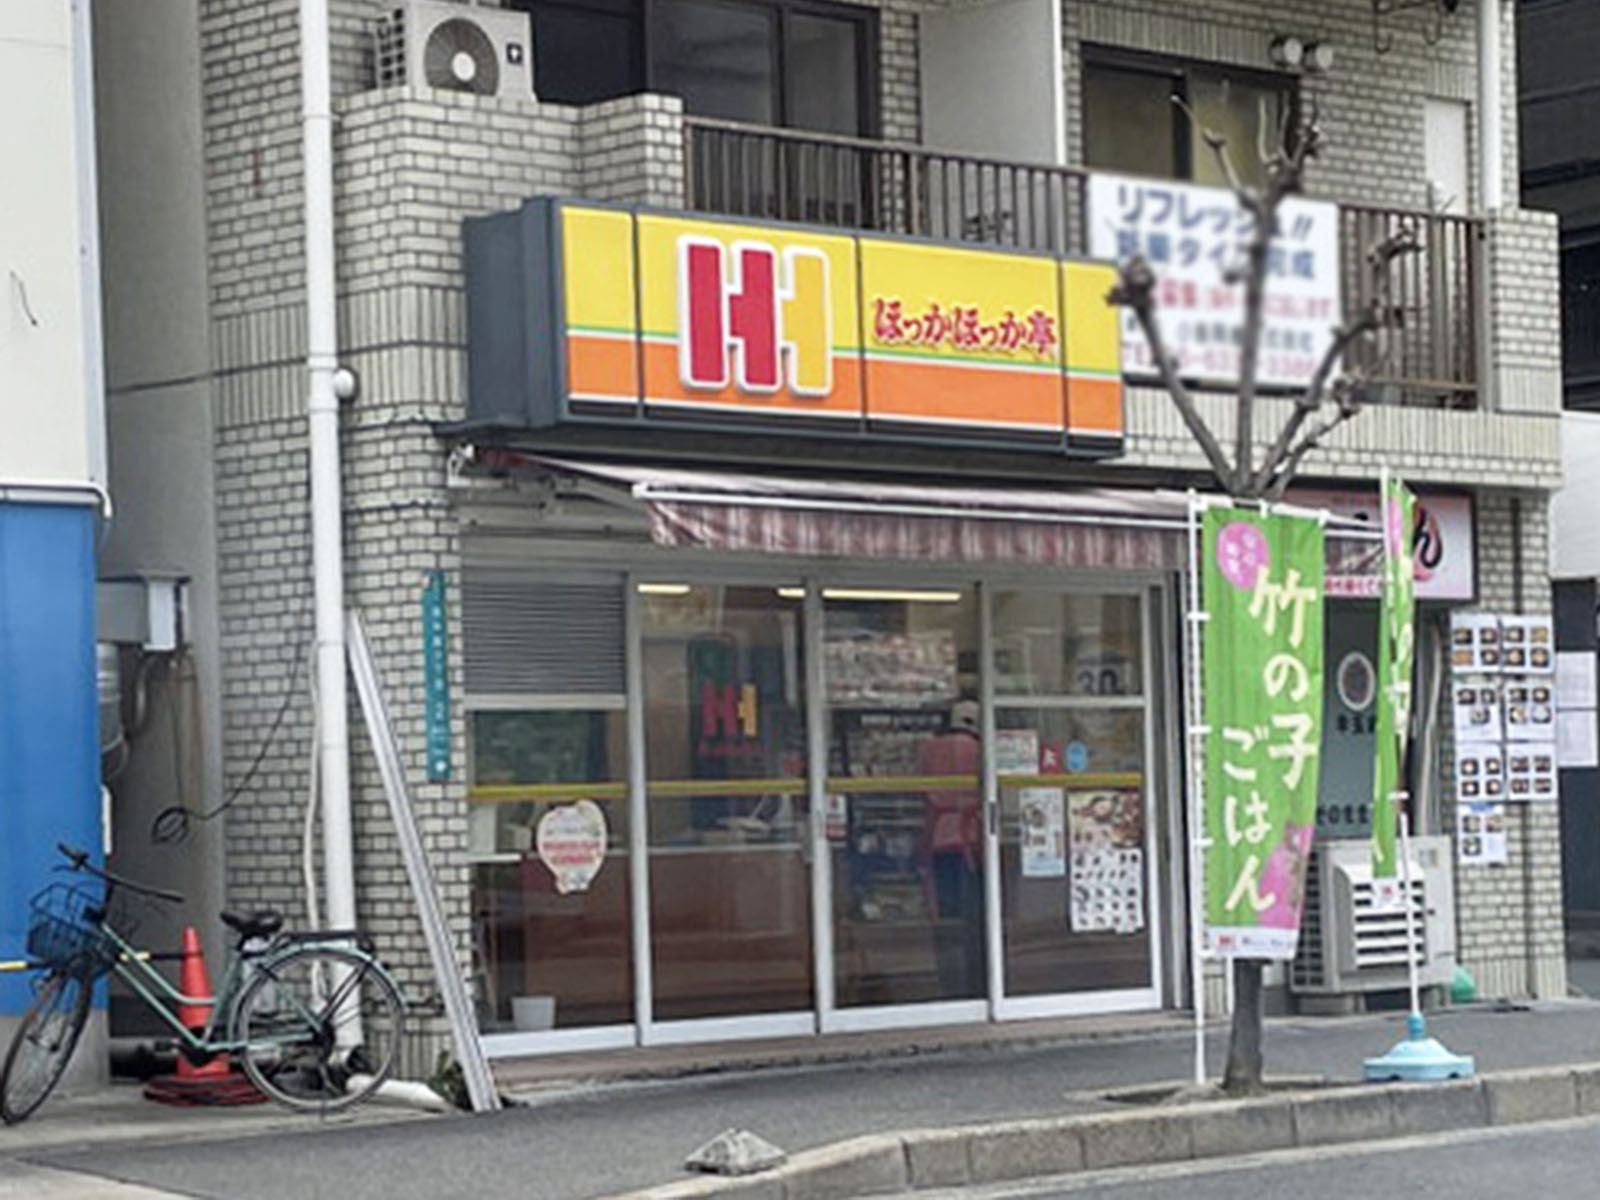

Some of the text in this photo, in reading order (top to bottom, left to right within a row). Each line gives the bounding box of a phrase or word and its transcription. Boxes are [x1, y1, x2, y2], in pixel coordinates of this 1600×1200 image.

[873, 296, 1058, 356] ほっかほっか亭
[1249, 564, 1319, 792] 竹の子
[1222, 724, 1277, 912] ごはん
